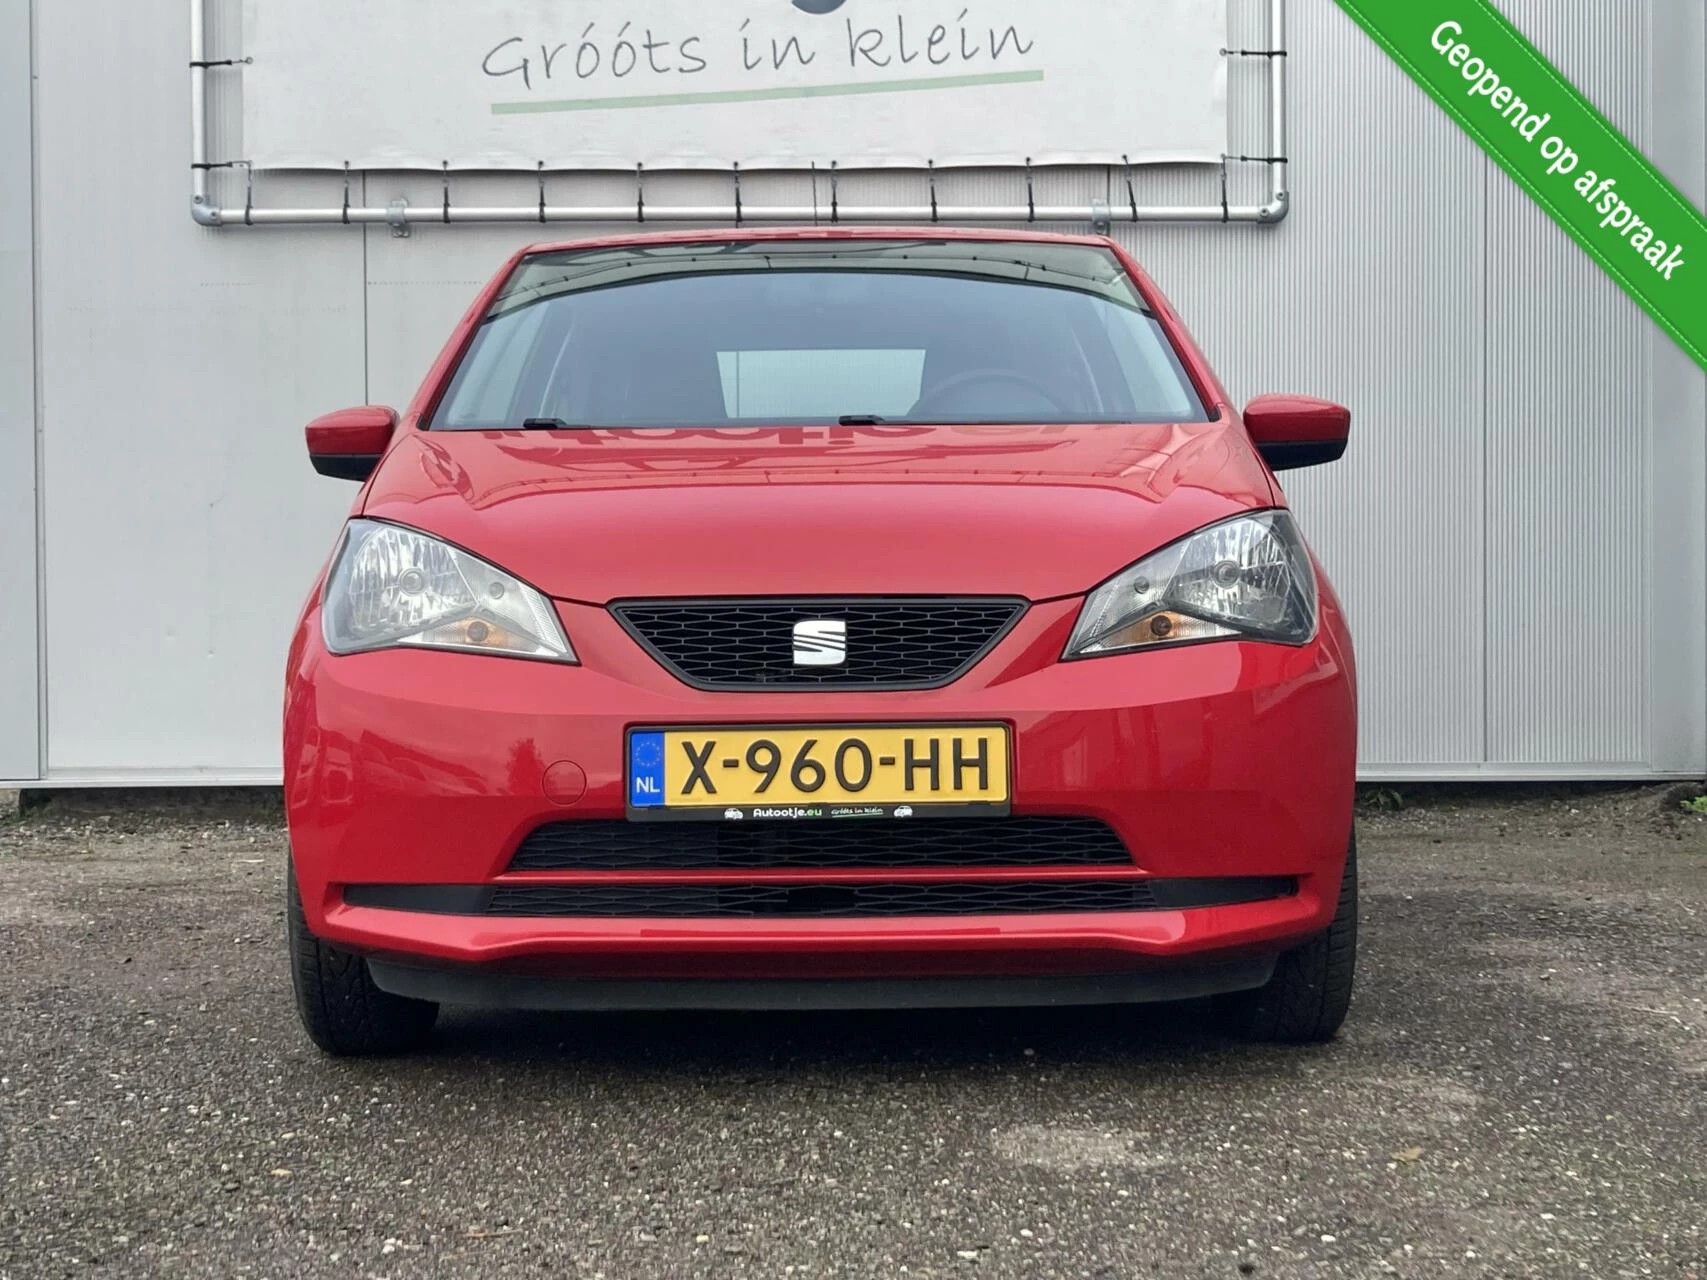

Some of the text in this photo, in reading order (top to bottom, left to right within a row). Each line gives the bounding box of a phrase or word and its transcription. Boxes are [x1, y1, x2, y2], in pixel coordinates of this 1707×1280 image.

[482, 21, 707, 90] Gróóts
[636, 776, 660, 793] NL
[681, 737, 990, 795] X-960-HH
[753, 807, 823, 819] Autootje.eu
